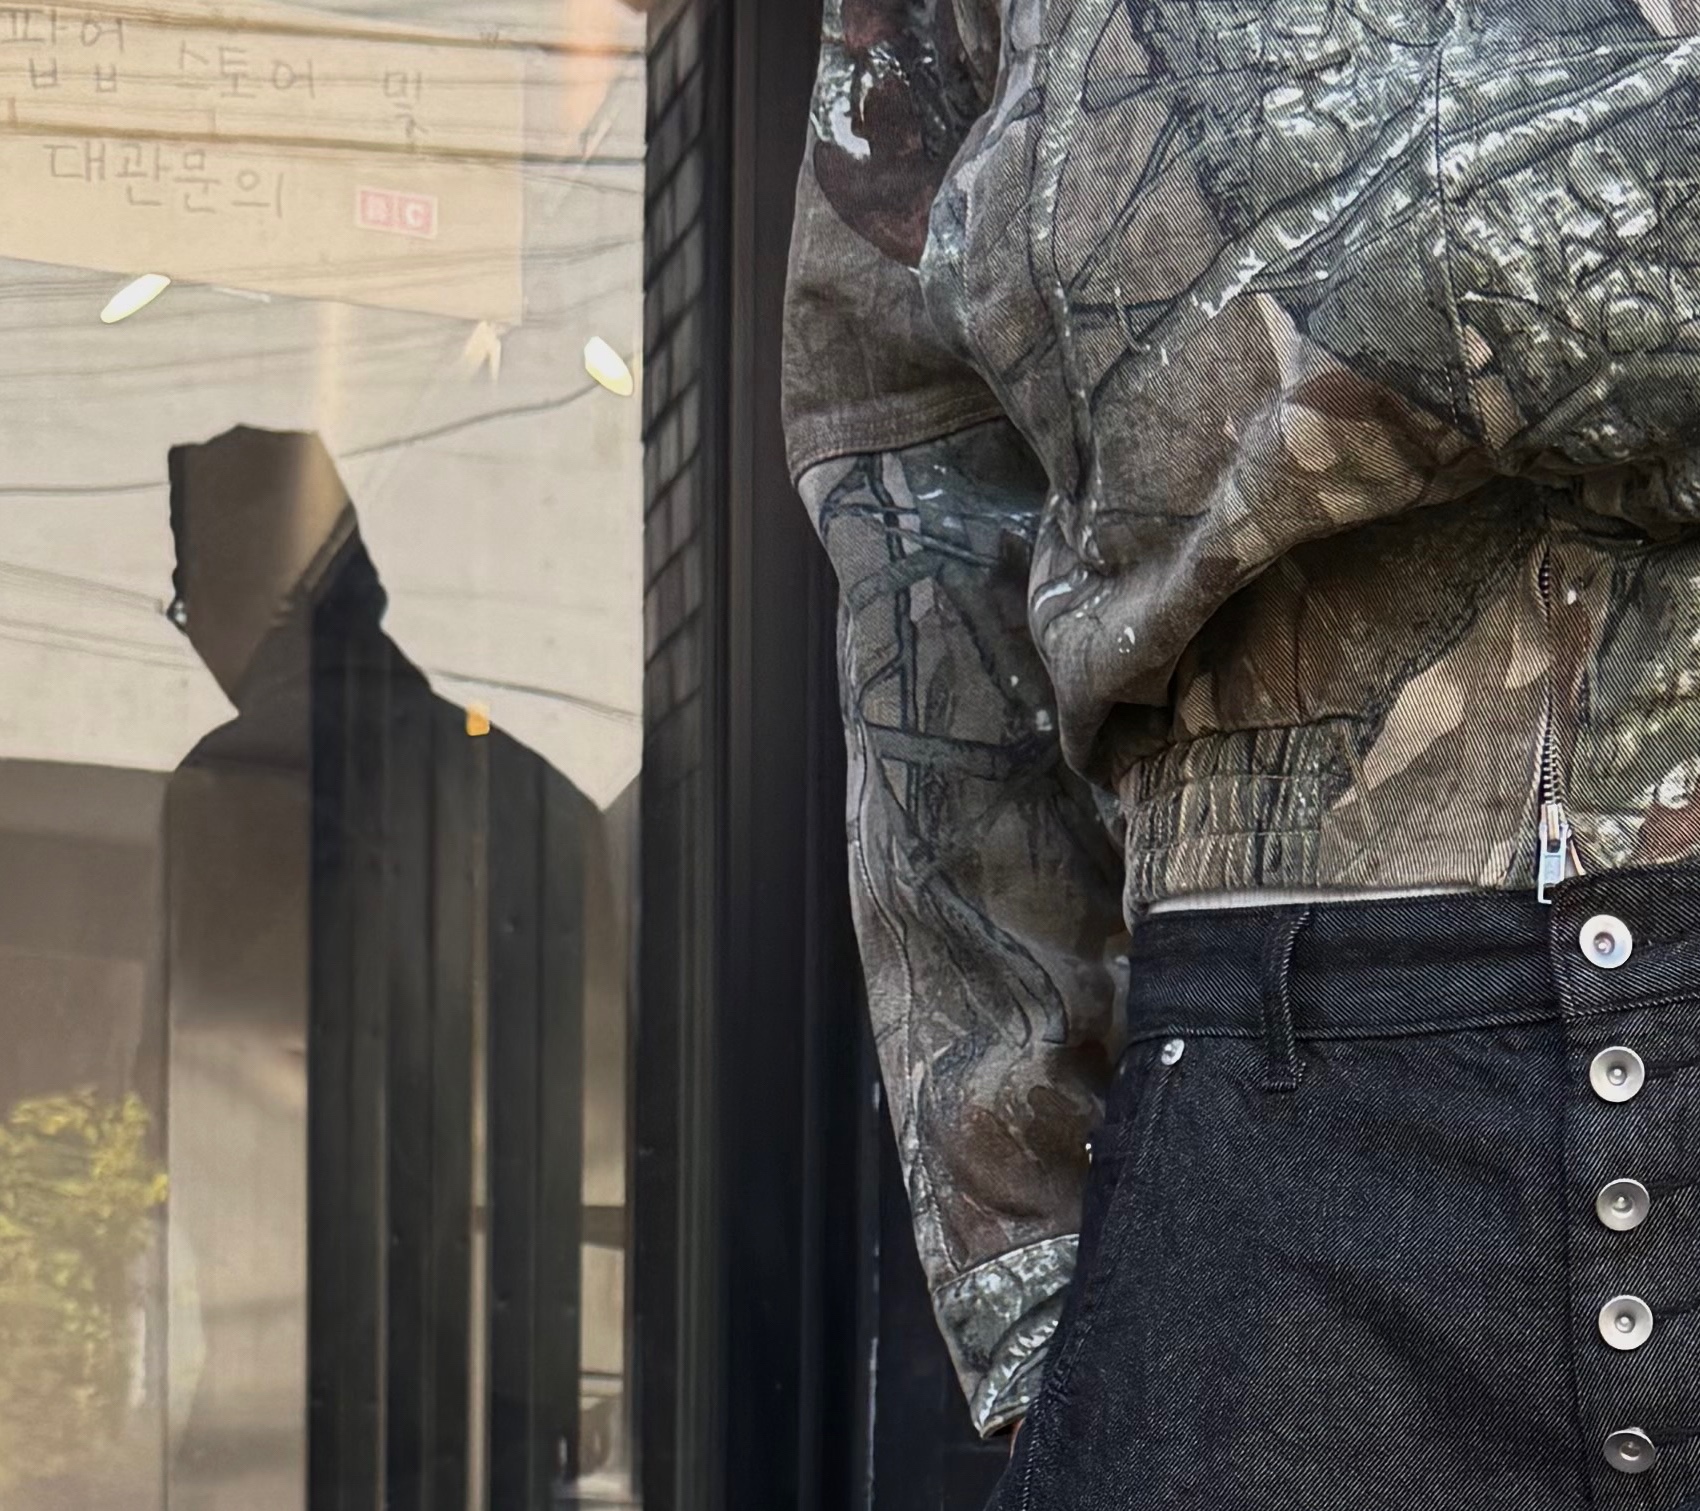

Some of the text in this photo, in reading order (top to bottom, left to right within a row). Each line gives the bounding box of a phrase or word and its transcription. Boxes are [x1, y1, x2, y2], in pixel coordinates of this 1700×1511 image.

[0, 7, 124, 93] 팝업
[174, 40, 316, 99] 스토어
[43, 140, 285, 219] 대관문의
